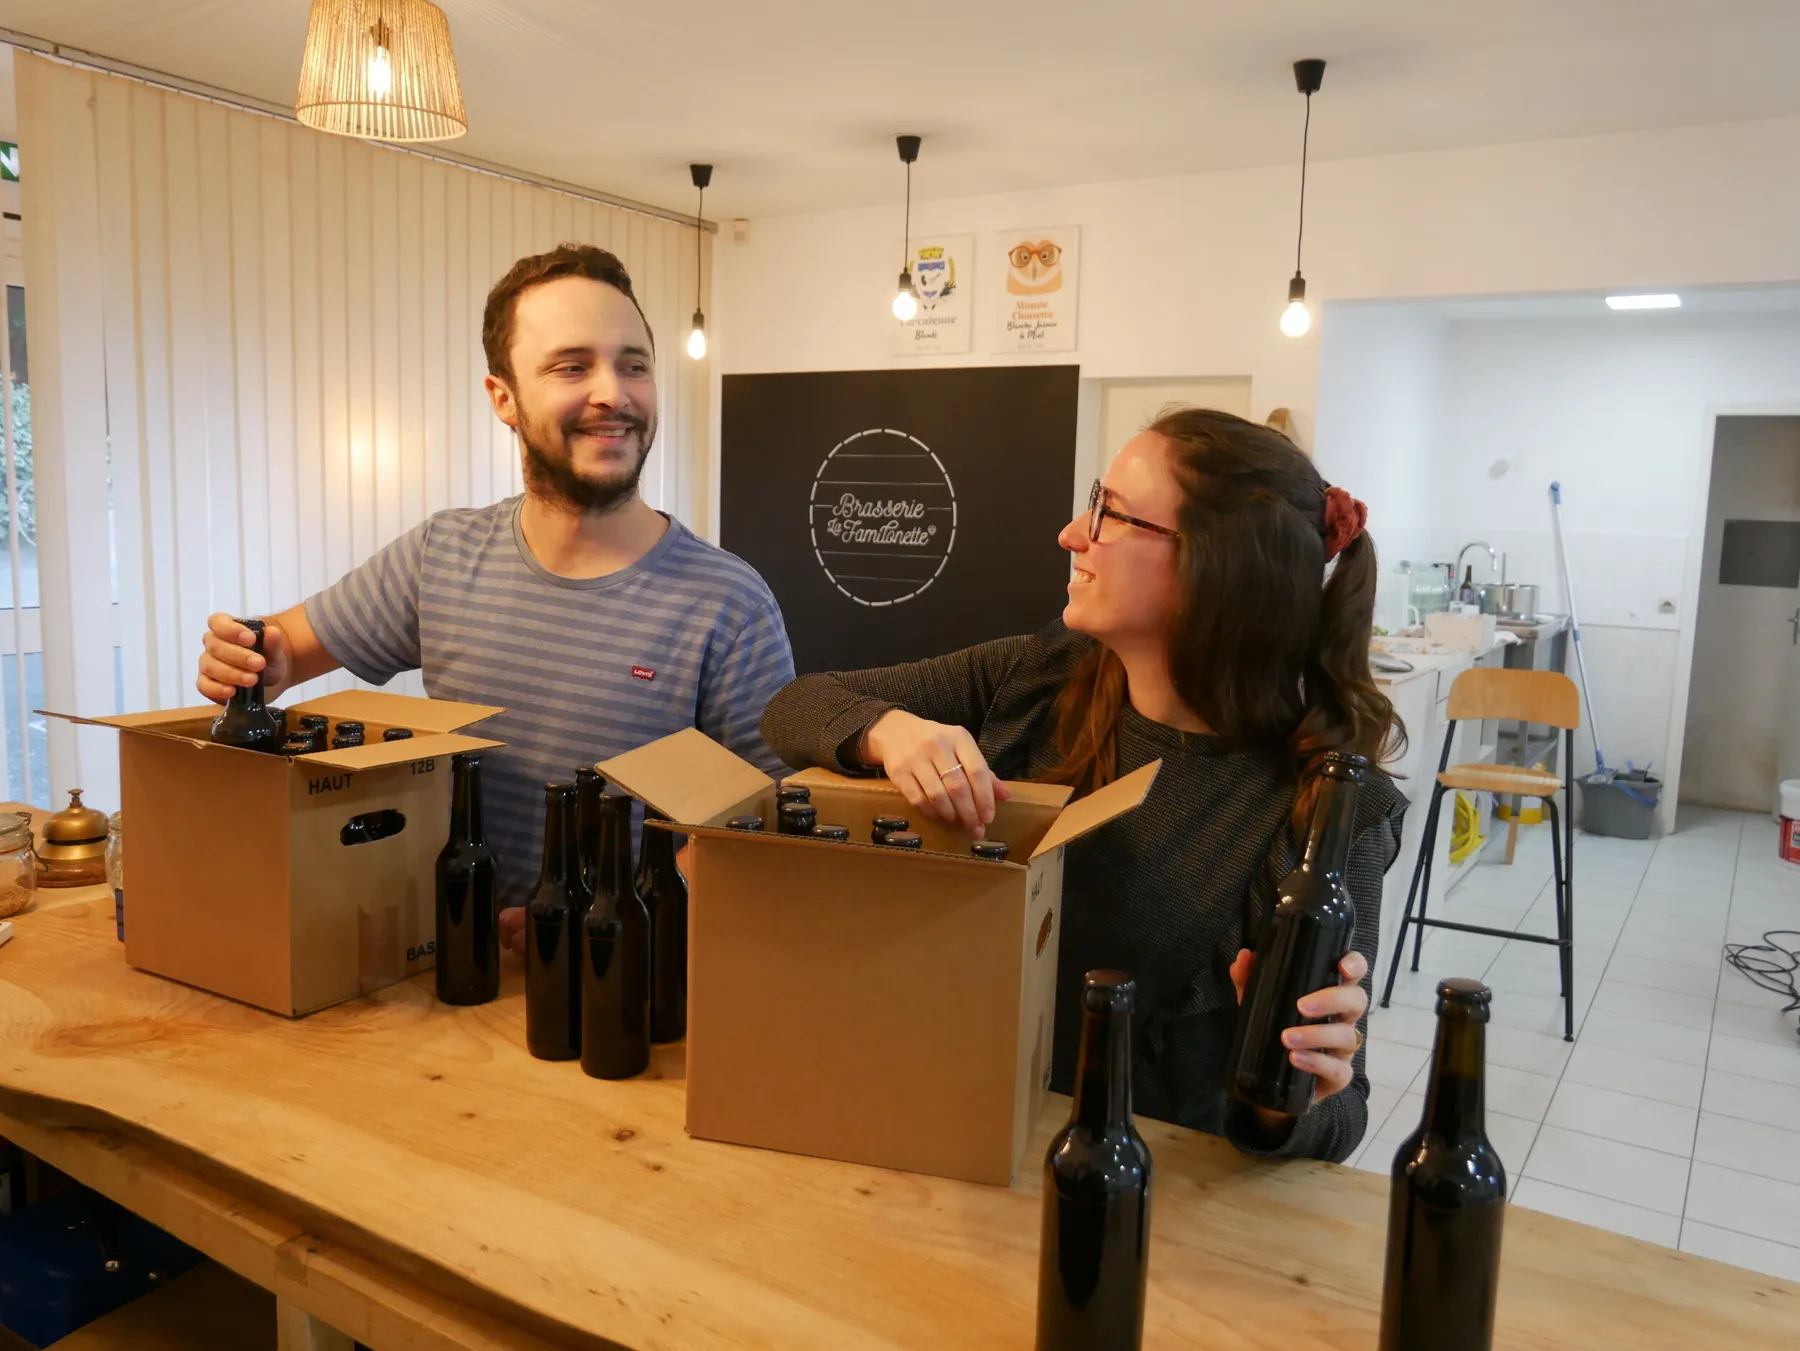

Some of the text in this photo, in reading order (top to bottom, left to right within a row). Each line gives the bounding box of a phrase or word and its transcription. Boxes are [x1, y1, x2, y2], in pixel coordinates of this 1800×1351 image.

[1012, 311, 1054, 320] Chouette
[1007, 321, 1032, 331] Blanche
[1027, 329, 1044, 340] Miel
[832, 493, 925, 519] Brasserie
[827, 518, 842, 536] La
[410, 759, 436, 776] 12B
[308, 773, 354, 796] HAUT
[406, 941, 436, 962] BAS
